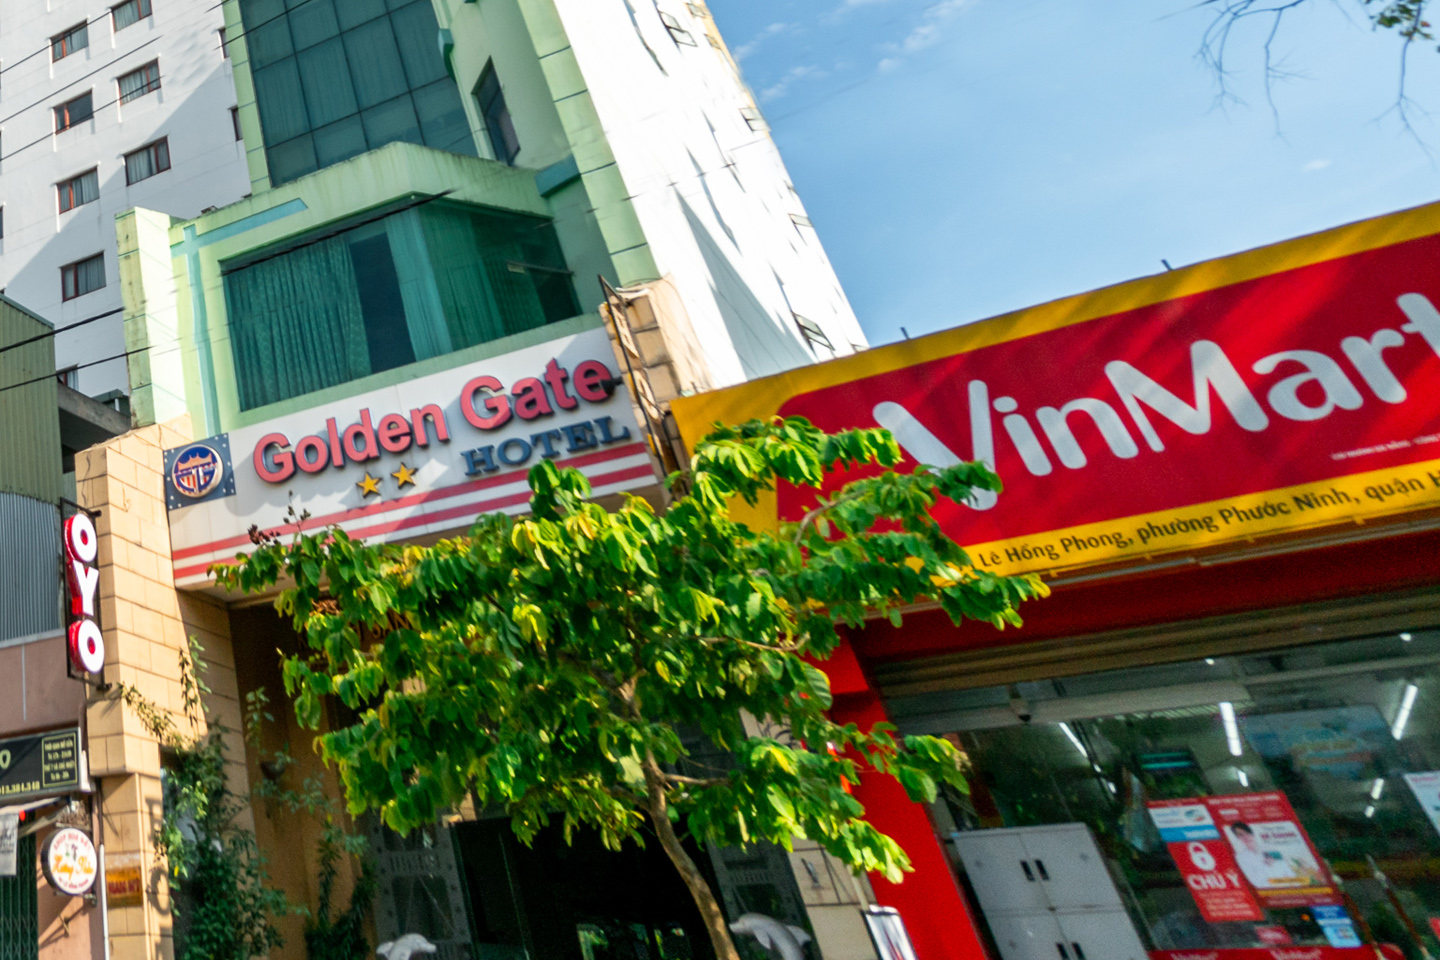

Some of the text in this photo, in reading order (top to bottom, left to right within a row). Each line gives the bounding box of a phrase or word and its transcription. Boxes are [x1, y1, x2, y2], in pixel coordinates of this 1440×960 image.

[253, 403, 450, 484] Golden
[459, 357, 613, 431] Gate
[460, 415, 631, 477] HOTEL
[978, 550, 1003, 568] Lê
[1364, 477, 1426, 503] quận
[65, 513, 105, 673] OYO
